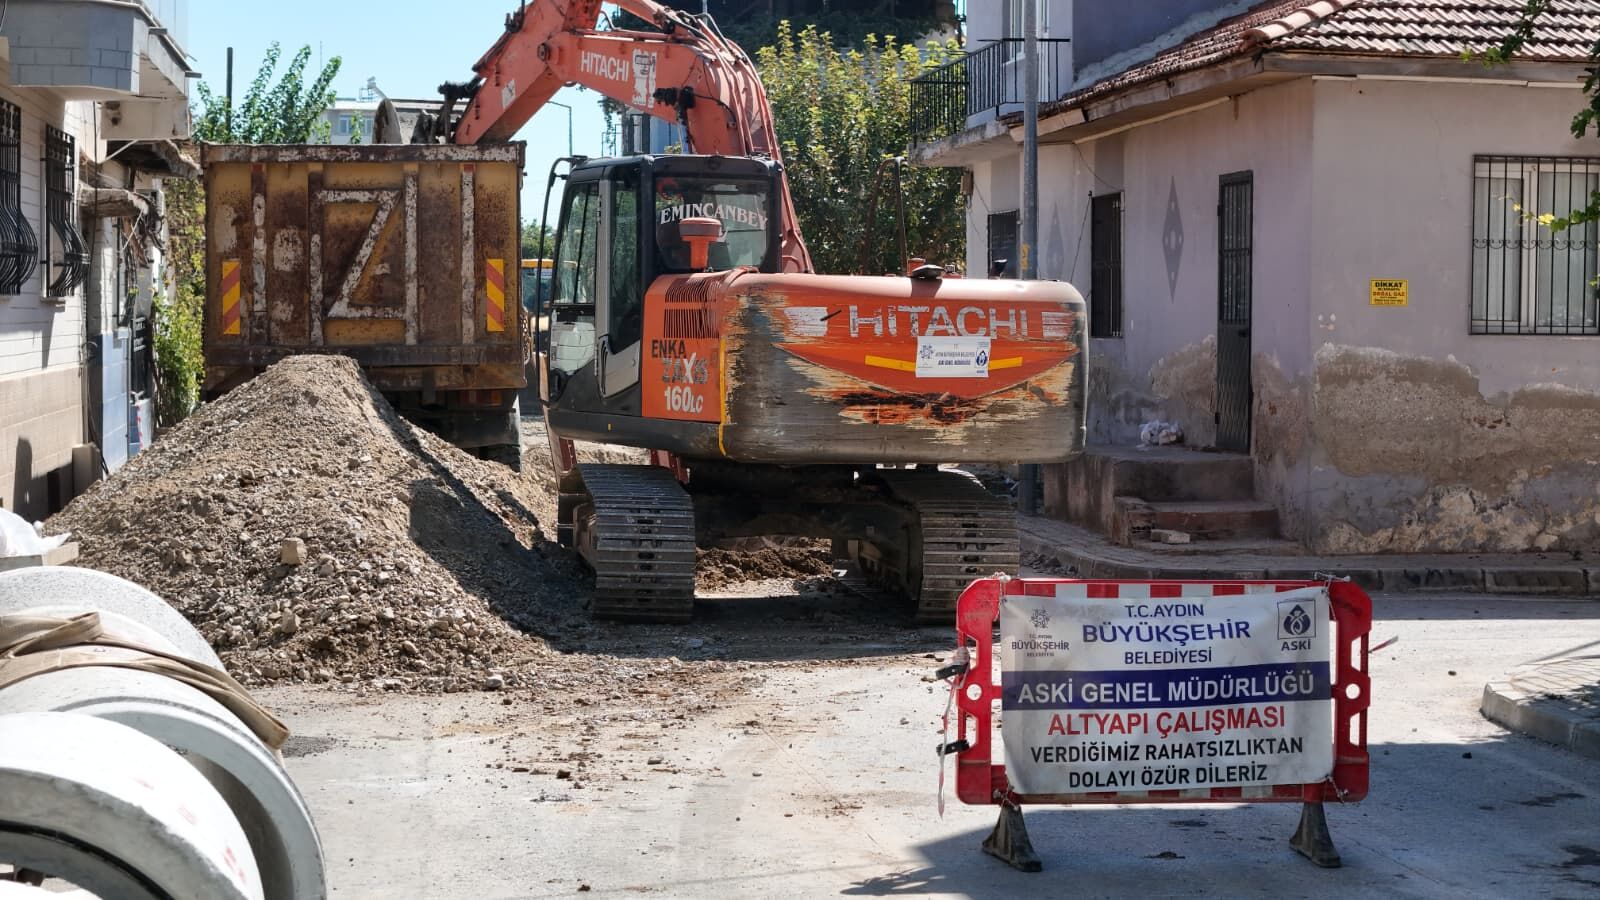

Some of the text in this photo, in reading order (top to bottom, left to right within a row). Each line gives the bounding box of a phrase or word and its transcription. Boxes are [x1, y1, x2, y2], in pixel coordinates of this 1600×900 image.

[580, 50, 630, 82] HITACHI
[660, 202, 768, 230] EMINCANBEY
[848, 304, 1029, 339] HITACHI
[651, 339, 687, 359] ENKA
[1011, 639, 1070, 652] BÜYÜKŞEHİR
[1082, 618, 1251, 646] BÜYÜKŞEHİR
[1280, 638, 1312, 652] ASKİ
[1124, 650, 1213, 665] BELEDİYESİ
[1018, 669, 1315, 704] ASKİ GENEL MÜDÜRLÜĞÜ
[1048, 705, 1285, 739] ALTYAPI ÇALIŞMASI
[1031, 737, 1304, 763] VERDİĞİMİZ RAHATSIZLIKTAN
[1069, 761, 1268, 788] DOLAYI ÖZÜR DİLERİZ
